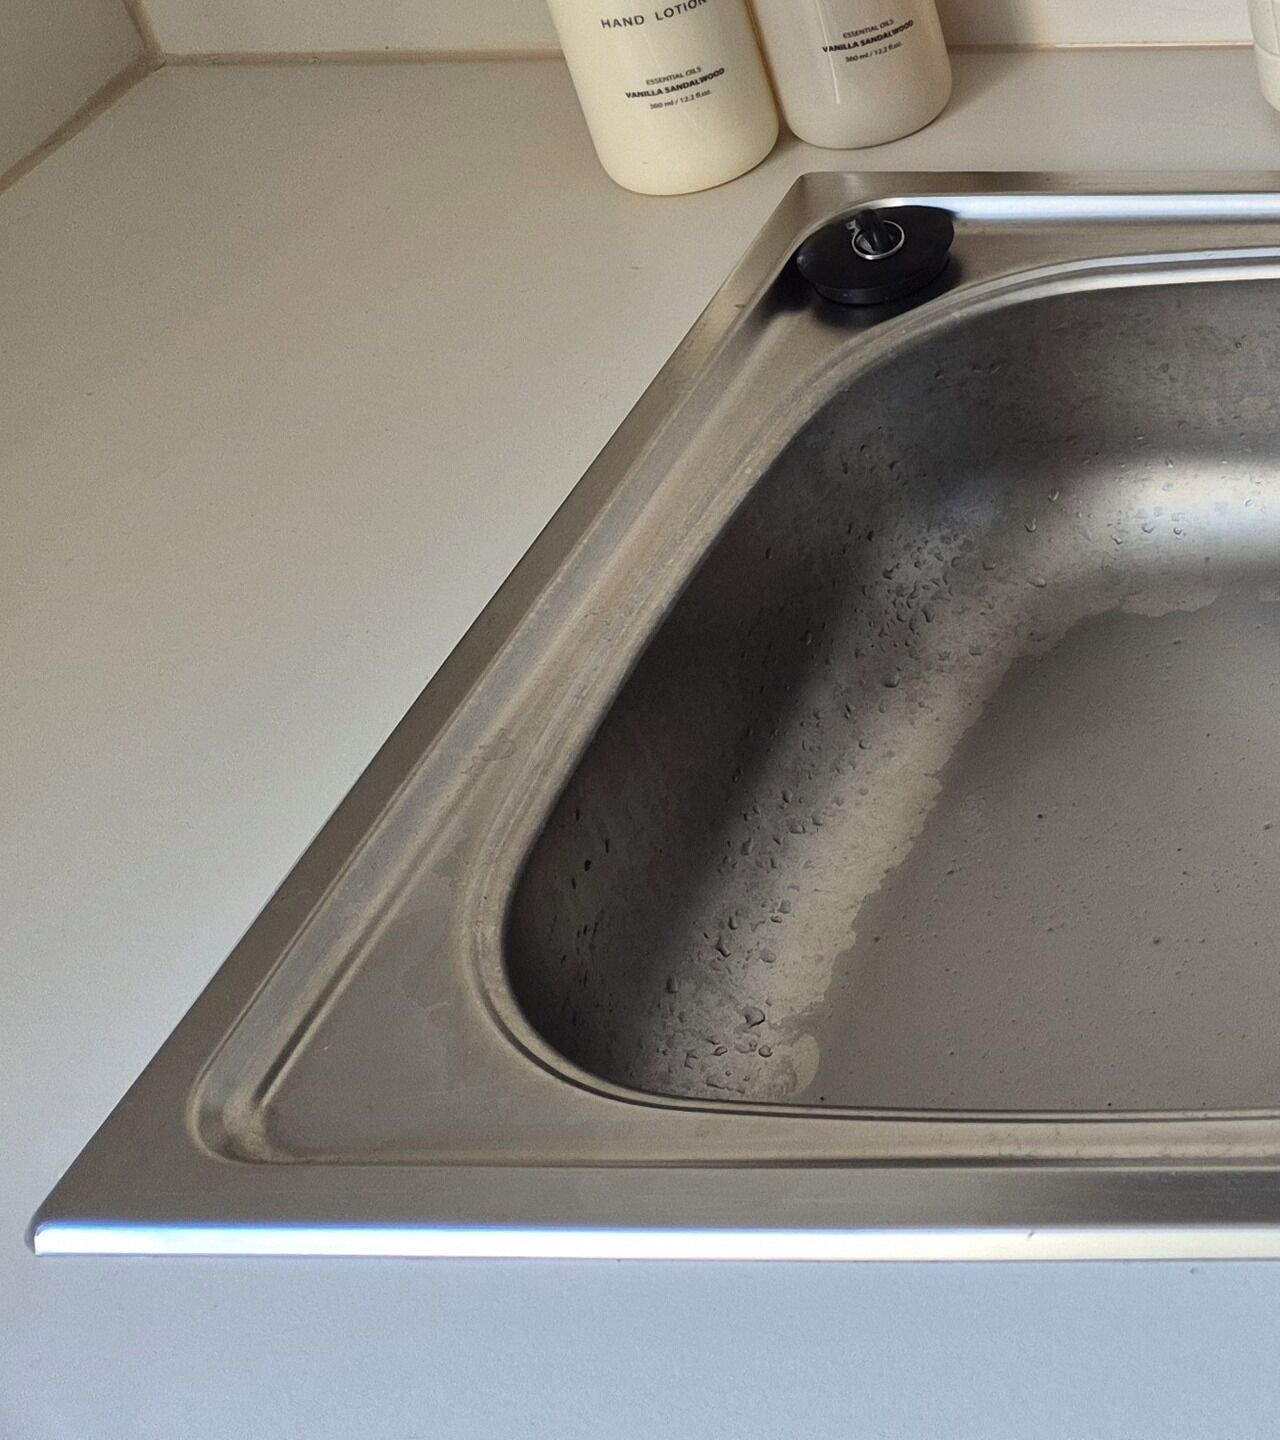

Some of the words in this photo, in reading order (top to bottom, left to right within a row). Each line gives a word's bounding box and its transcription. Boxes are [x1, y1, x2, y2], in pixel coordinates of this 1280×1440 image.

[601, 14, 645, 29] HAND
[822, 41, 859, 53] VANILLA
[860, 20, 914, 47] SANDALWOOD
[843, 25, 879, 39] ESSENTIAL
[625, 88, 663, 98] VANILLA
[665, 67, 725, 94] SANDALWOOD
[646, 73, 684, 86] ESSENTIAL
